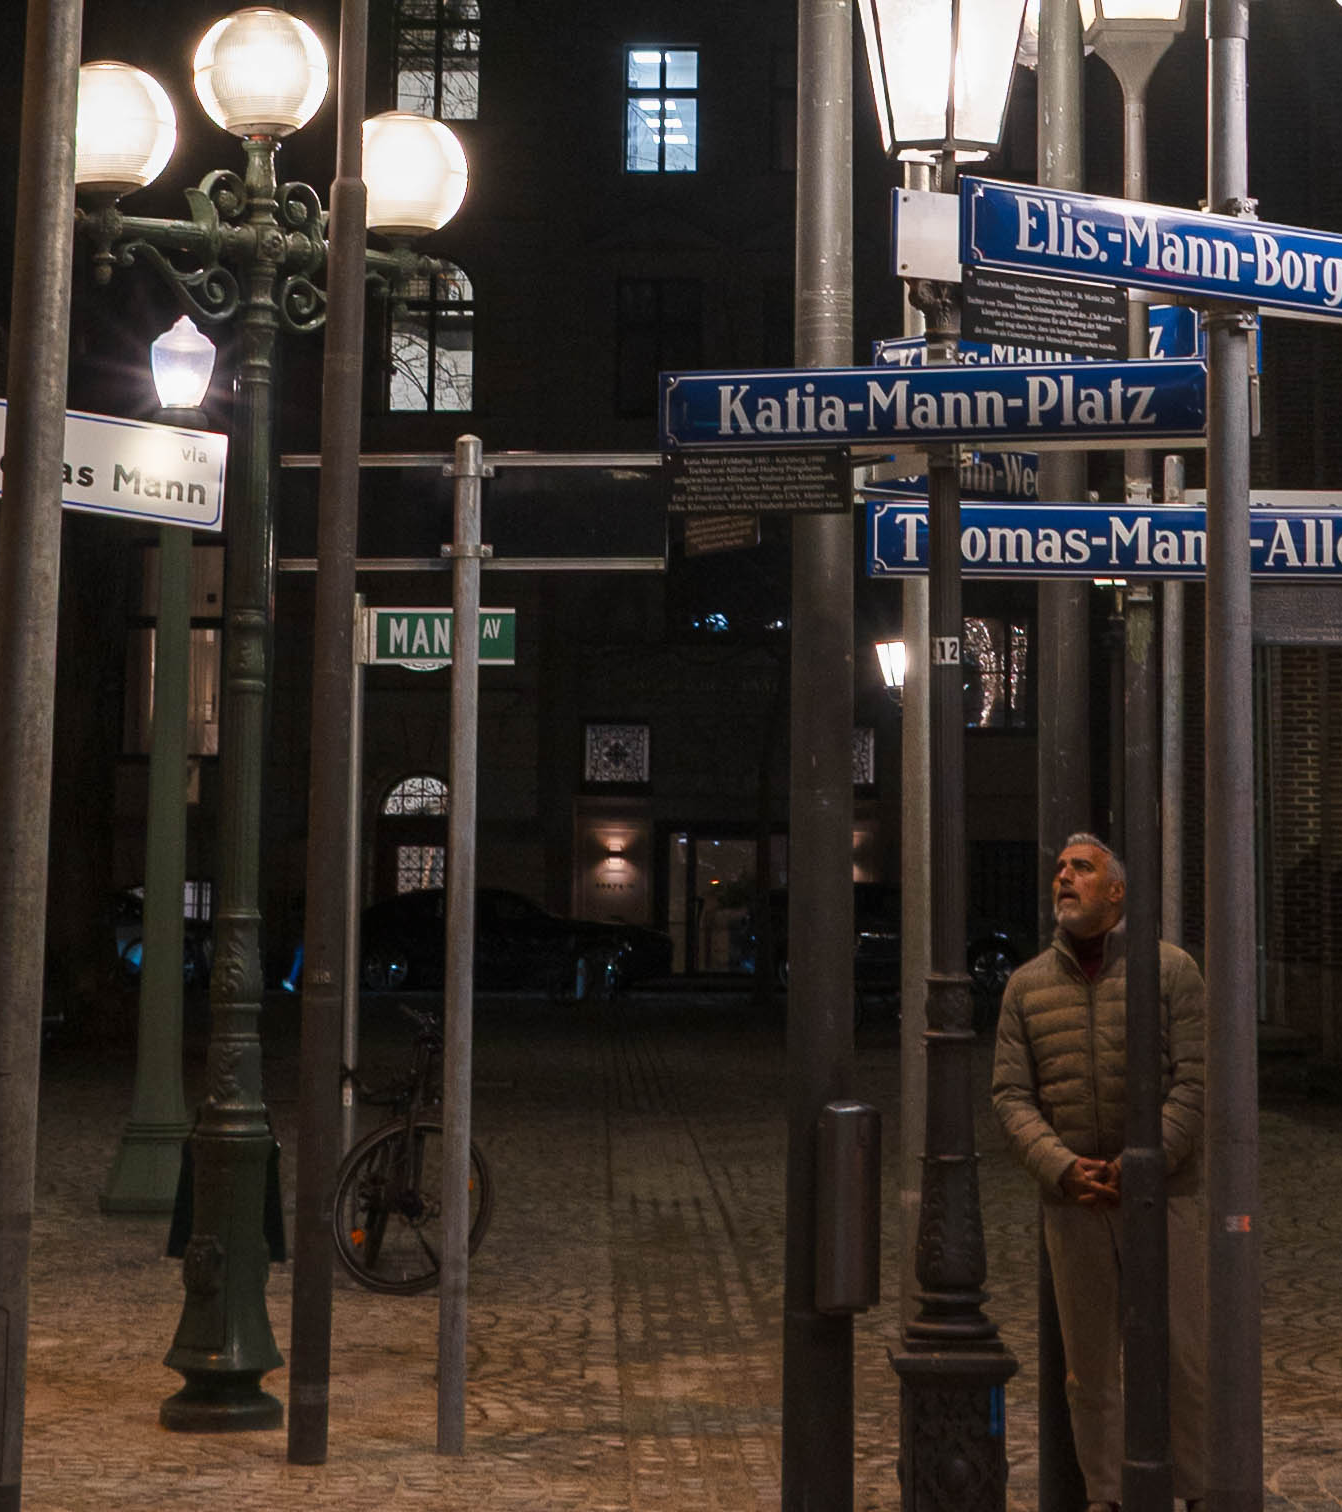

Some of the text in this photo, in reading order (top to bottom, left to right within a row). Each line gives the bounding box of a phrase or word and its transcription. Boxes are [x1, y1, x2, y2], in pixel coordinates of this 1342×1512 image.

[717, 375, 1158, 436] Katia-Mann-Platz
[181, 446, 208, 464] via
[113, 463, 206, 506] Mann
[389, 617, 501, 654] MAN AV
